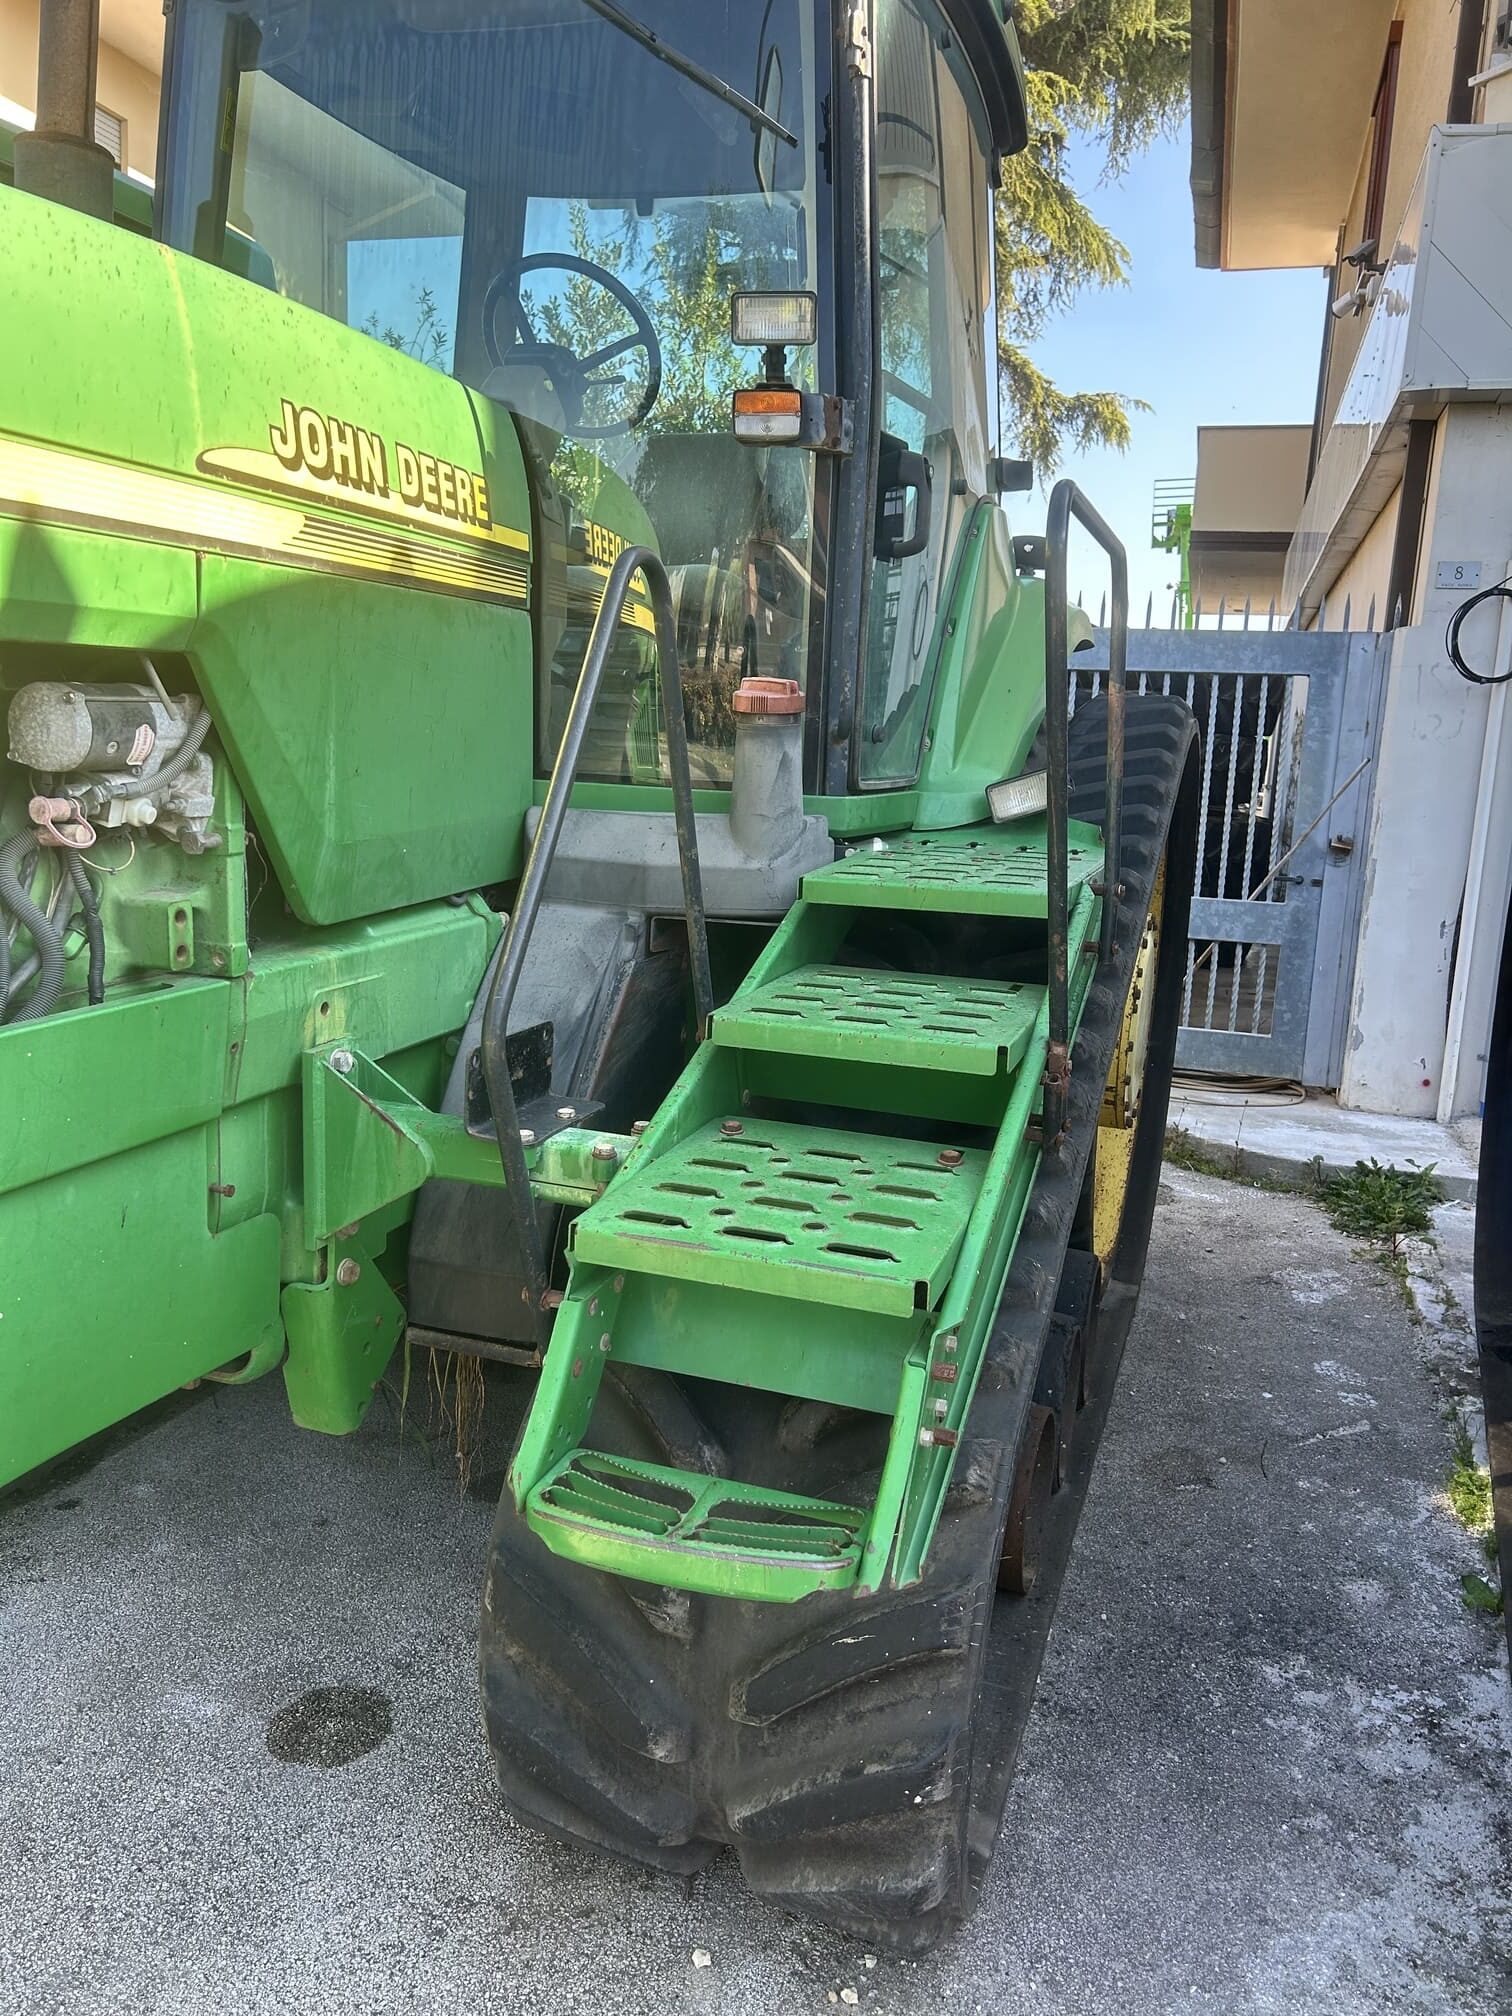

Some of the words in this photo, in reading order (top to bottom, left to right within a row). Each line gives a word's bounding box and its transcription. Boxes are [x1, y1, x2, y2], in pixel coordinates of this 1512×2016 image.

[269, 397, 390, 499] JOHN
[395, 441, 492, 531] DEERE
[1454, 565, 1464, 580] 8
